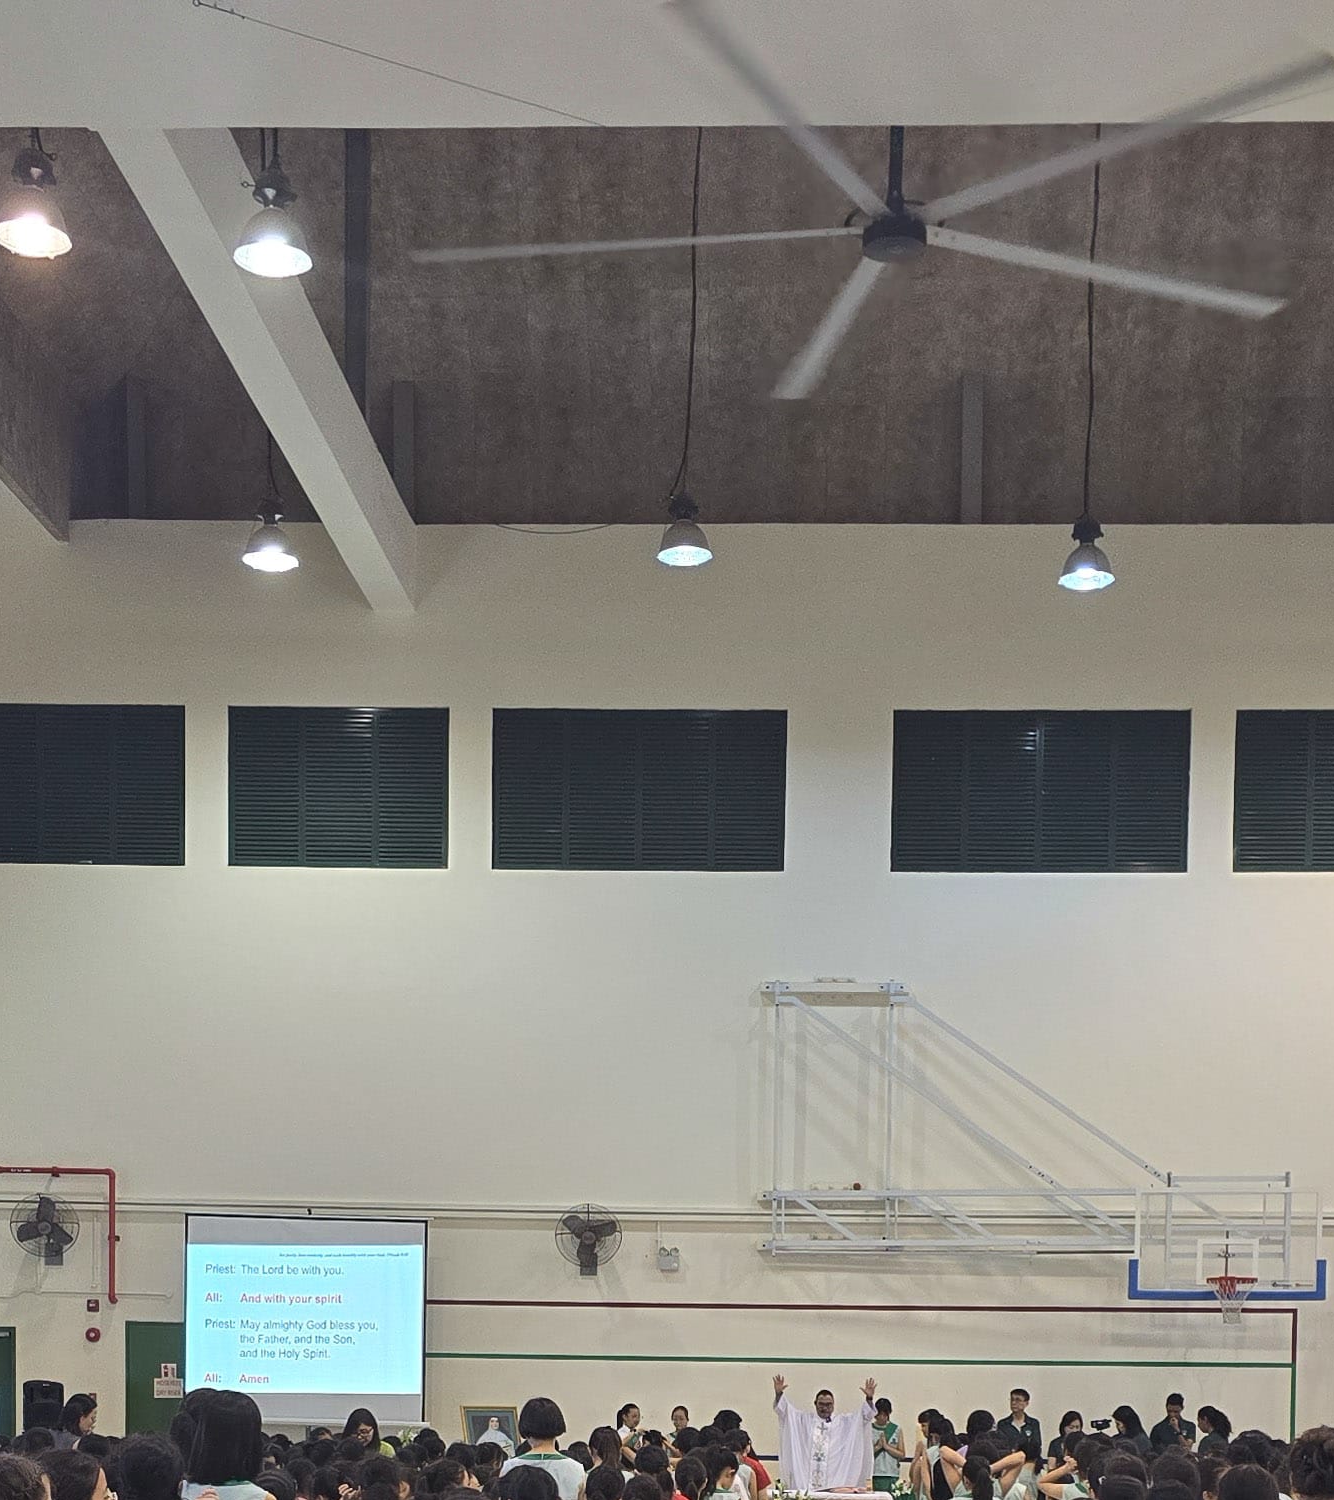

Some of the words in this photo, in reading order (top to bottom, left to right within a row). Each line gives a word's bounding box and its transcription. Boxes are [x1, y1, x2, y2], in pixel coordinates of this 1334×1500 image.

[205, 1264, 235, 1274] Priest:
[242, 1264, 259, 1274] The
[262, 1265, 284, 1275] Lord
[287, 1265, 298, 1275] be
[301, 1265, 321, 1275] with
[323, 1267, 344, 1277] you.
[205, 1293, 222, 1302] All:
[240, 1293, 261, 1303] And
[264, 1294, 285, 1303] with
[289, 1296, 312, 1306] your
[205, 1319, 235, 1329] Priest:
[240, 1320, 260, 1331] May
[263, 1320, 303, 1331] almighty
[306, 1320, 326, 1330] God
[329, 1320, 355, 1330] bless
[358, 1322, 378, 1332] you,
[240, 1334, 255, 1344] the
[294, 1335, 312, 1344] and
[315, 1335, 330, 1344] the
[239, 1349, 258, 1358] and
[261, 1349, 275, 1358] the
[279, 1349, 300, 1360] Holy
[204, 1373, 221, 1383] All:
[239, 1374, 269, 1383] Amen
